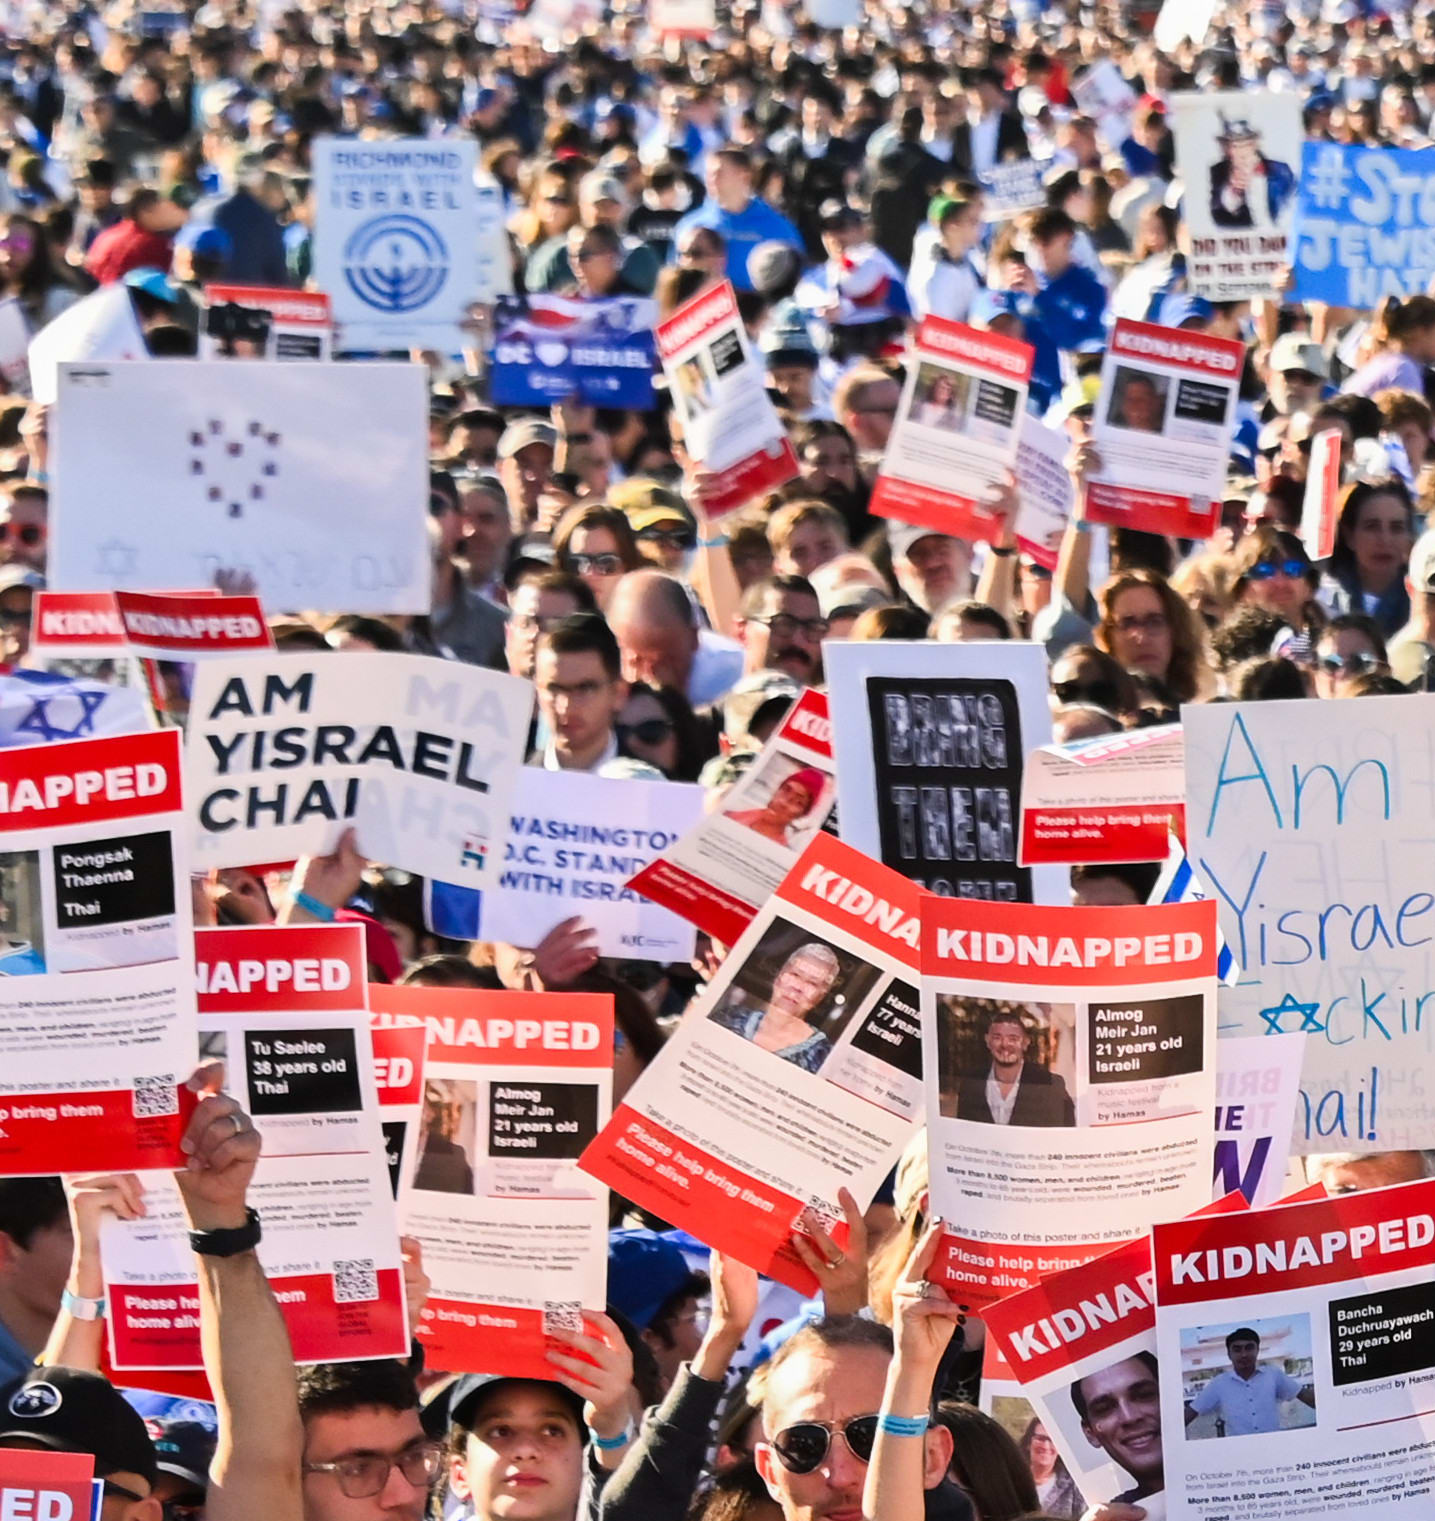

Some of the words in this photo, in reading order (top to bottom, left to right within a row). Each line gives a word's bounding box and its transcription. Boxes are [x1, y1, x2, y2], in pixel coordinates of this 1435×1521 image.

[331, 191, 461, 209] ISRAEL
[571, 348, 653, 368] ISRAEL
[922, 326, 1029, 376] KIDNAPPED
[1112, 328, 1238, 373] KIDNAPPED
[210, 671, 314, 721] AM
[206, 724, 491, 792] YISRAEL
[1206, 711, 1391, 837] Am
[199, 777, 361, 833] CHAI
[60, 849, 133, 870] Pongsak
[60, 870, 134, 889] Thaenna
[63, 899, 101, 918] Thai
[935, 923, 1203, 970] KIDNAPPED
[251, 1041, 272, 1057] Tu
[276, 1038, 326, 1058] Saelee
[253, 1079, 289, 1095] Thai
[1336, 1302, 1384, 1322] Bancha
[1340, 1350, 1368, 1368] Thai
